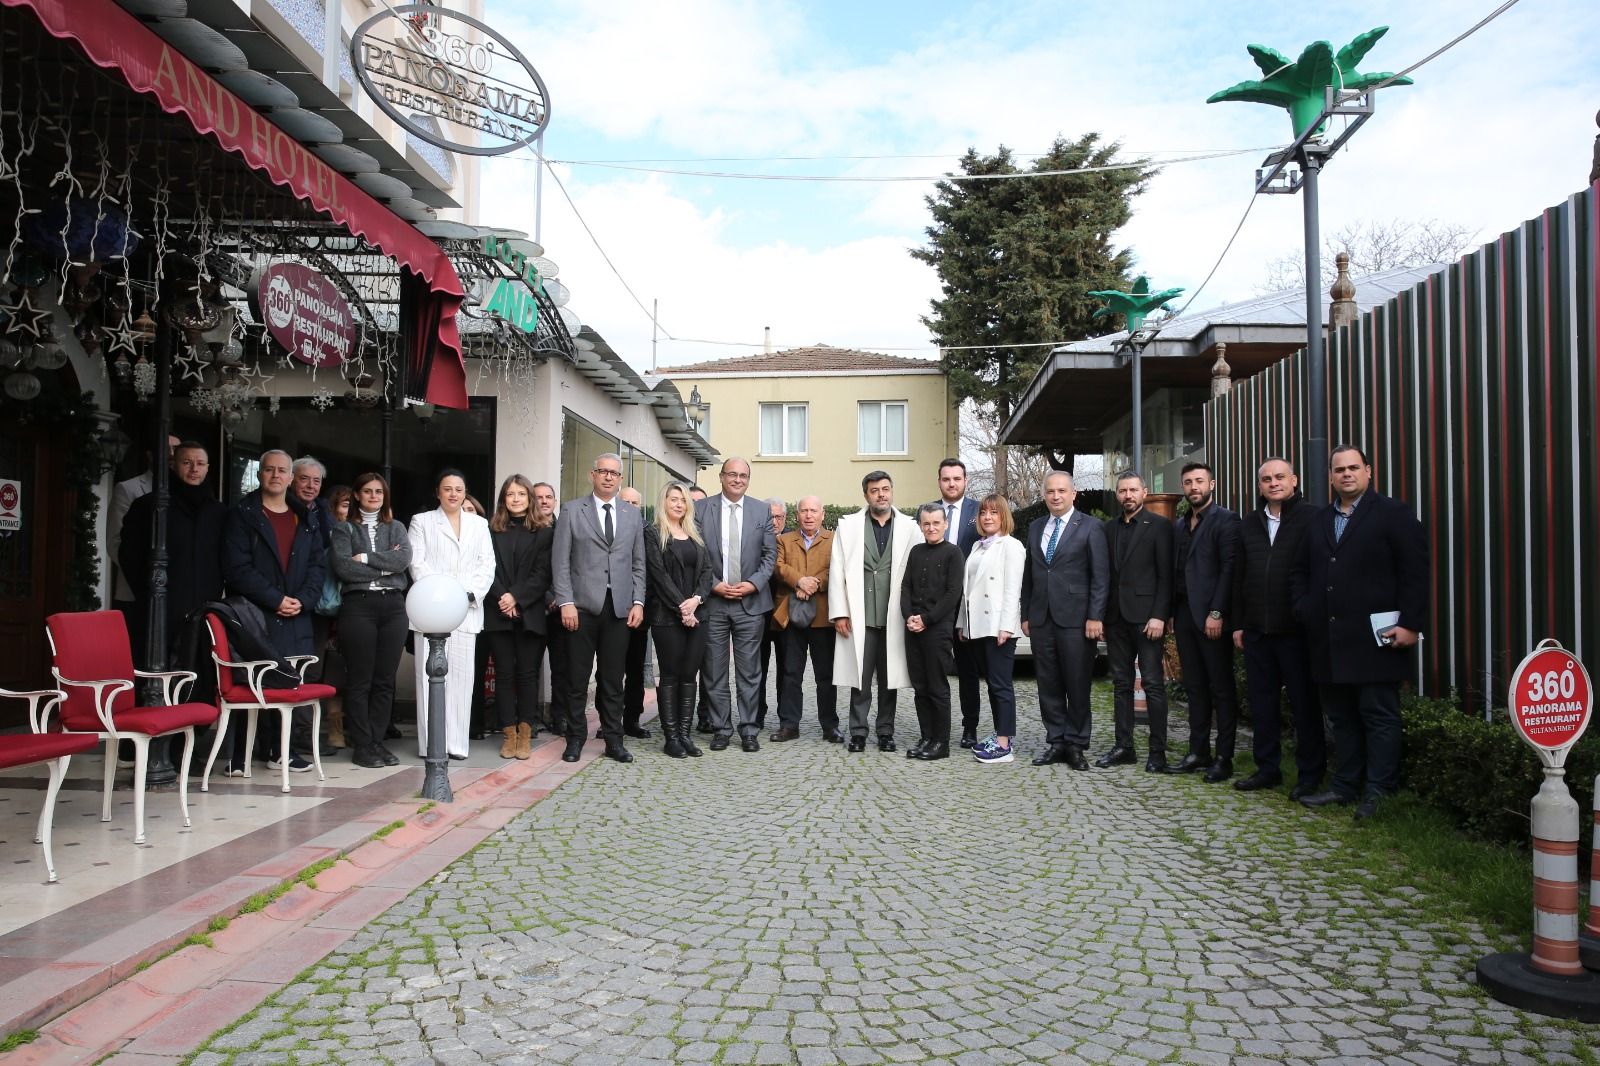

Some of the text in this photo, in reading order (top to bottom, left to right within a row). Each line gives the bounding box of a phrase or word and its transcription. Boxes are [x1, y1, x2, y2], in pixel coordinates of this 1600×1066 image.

[362, 42, 545, 126] PANORAMA
[153, 43, 346, 213] AND HOTEL
[382, 82, 524, 143] RESTAURANT
[294, 288, 344, 328] PANORAMA
[485, 277, 538, 334] AND
[293, 313, 350, 353] RESTAURANT
[0, 520, 19, 528] NTRANCE
[1522, 701, 1582, 715] PANORAMA
[1525, 714, 1581, 726] RESTAURANT
[1530, 725, 1575, 734] SULTANAHMET
